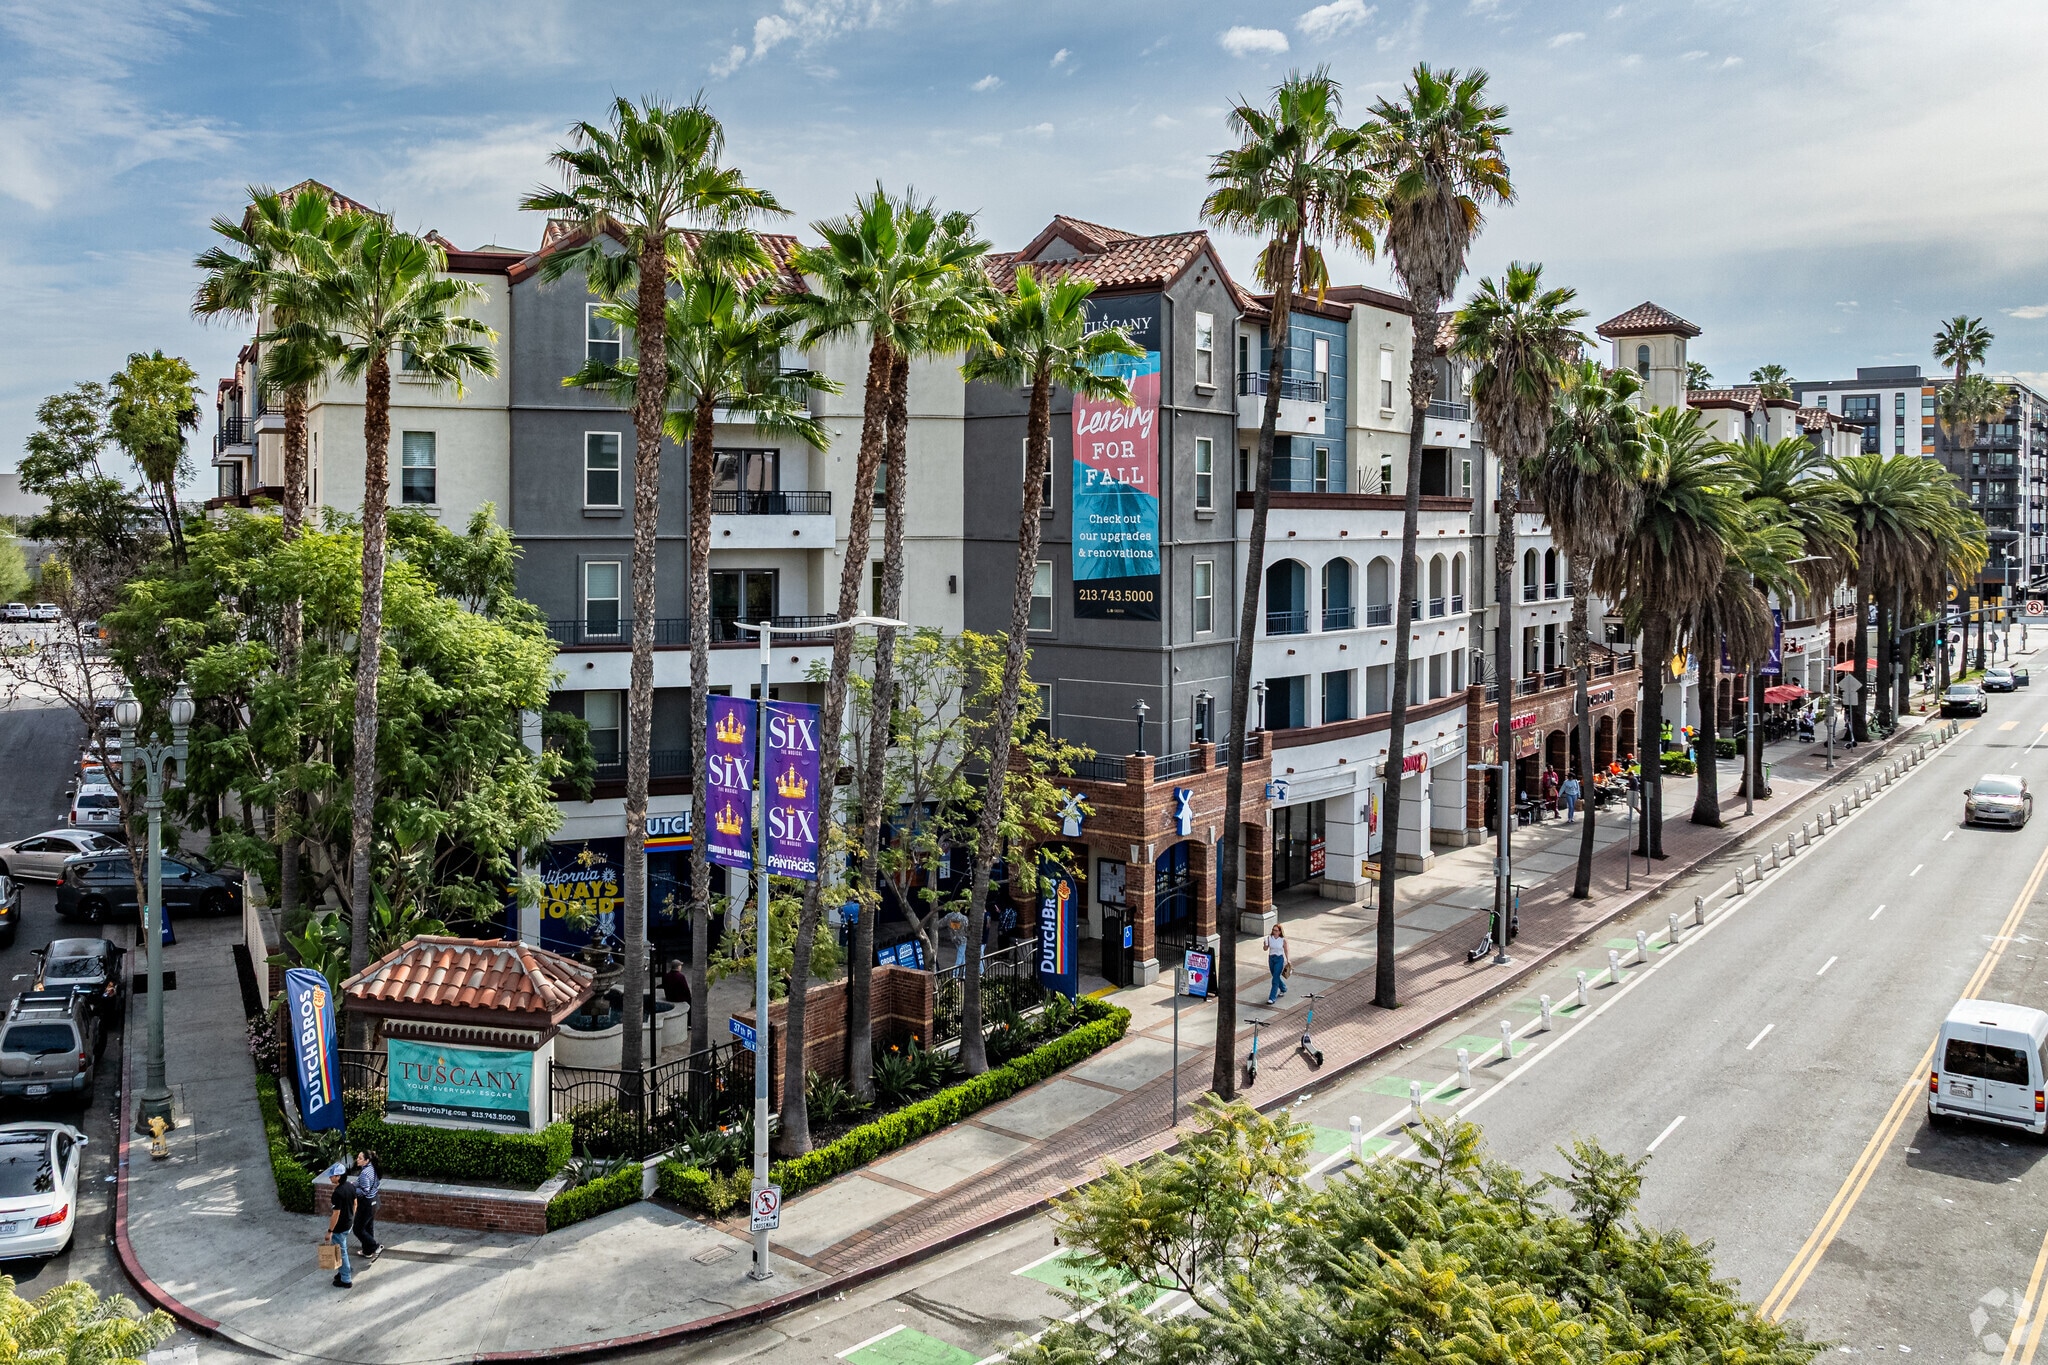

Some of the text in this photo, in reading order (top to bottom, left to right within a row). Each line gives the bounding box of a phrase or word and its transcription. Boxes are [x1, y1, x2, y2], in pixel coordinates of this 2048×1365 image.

[1083, 316, 1153, 335] TUSCANY
[1076, 405, 1155, 439] Leasing
[1092, 441, 1136, 460] FOR
[1085, 466, 1144, 486] FALL
[1089, 514, 1141, 524] Check out
[1079, 531, 1152, 543] our upgrades
[1078, 548, 1154, 558] & renovations
[1079, 589, 1154, 602] 213.743.5000
[647, 811, 692, 835] UTCH
[767, 855, 816, 873] PANTAGES
[1041, 921, 1056, 974] DUTCH
[300, 989, 324, 1115] DUTCH BROS
[398, 1061, 523, 1091] TUSCANY
[433, 1086, 476, 1095] EVERYDAY
[479, 1090, 513, 1099] ESCAPE
[402, 1103, 516, 1122] TuscanyOnFig.com 213.743.5000
